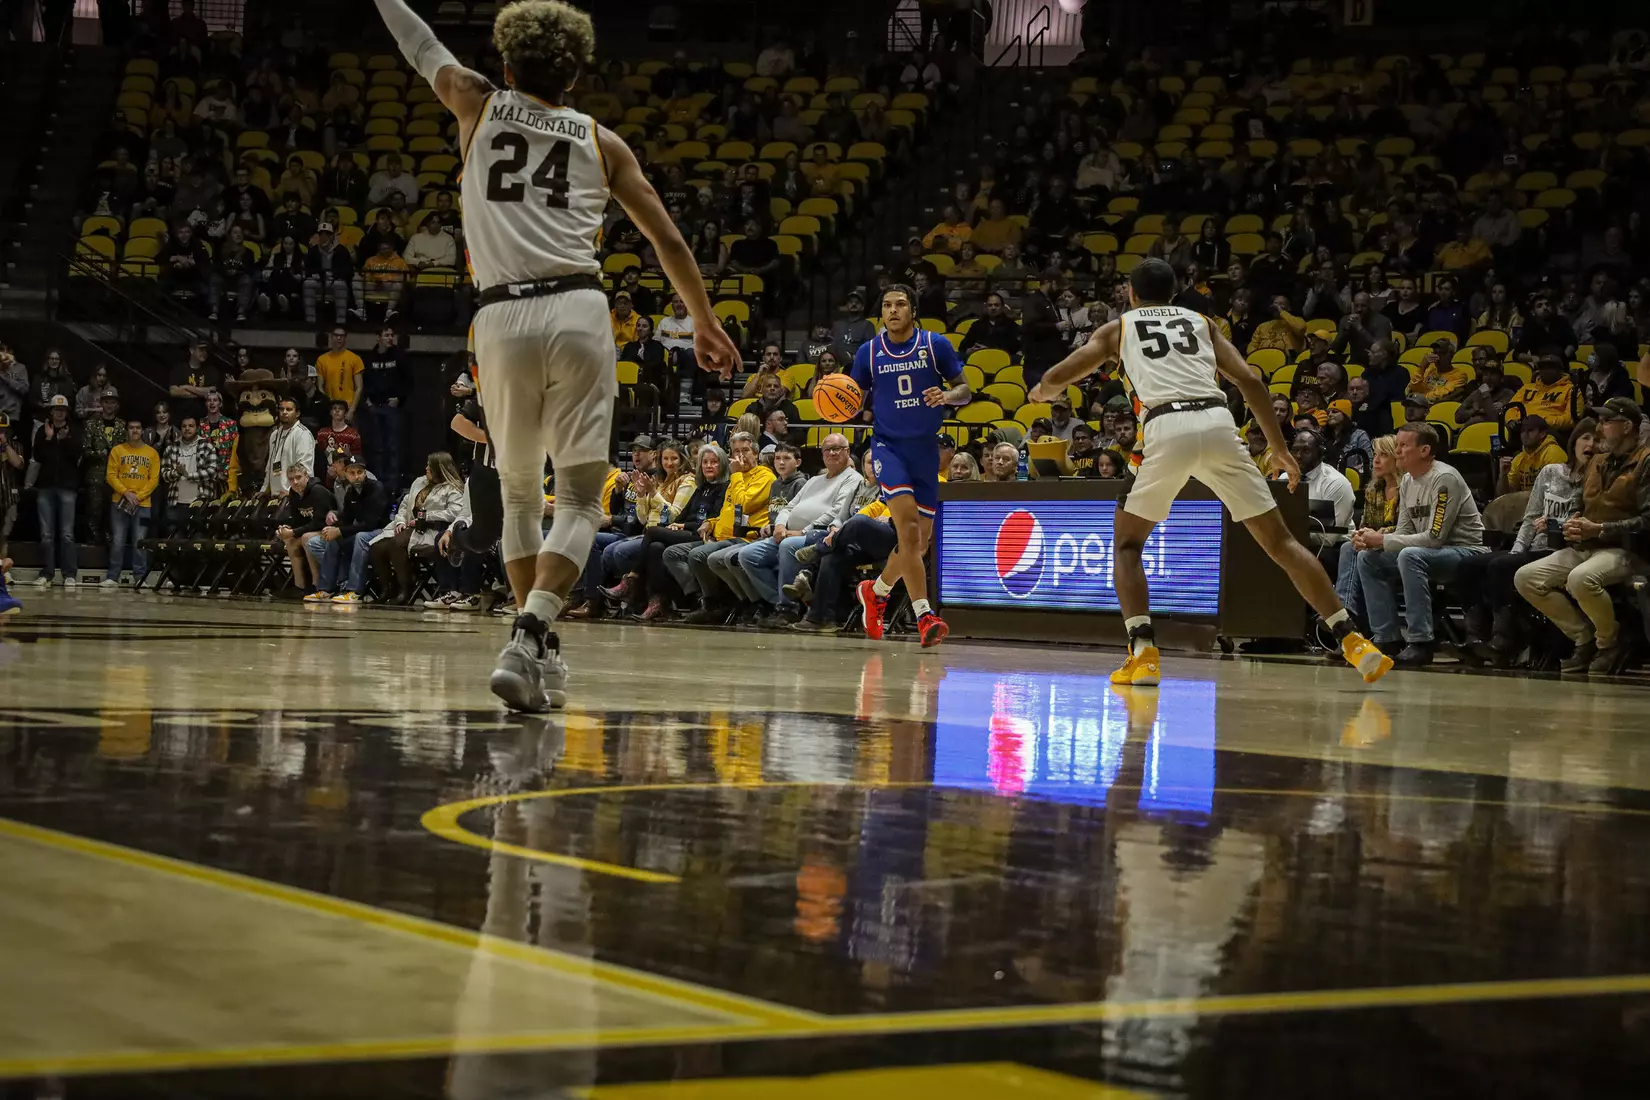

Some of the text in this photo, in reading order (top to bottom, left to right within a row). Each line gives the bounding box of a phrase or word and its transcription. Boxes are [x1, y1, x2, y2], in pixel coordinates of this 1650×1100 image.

[489, 104, 587, 140] MALDONADO
[487, 131, 571, 209] 24
[1138, 307, 1183, 317] DUSELL
[1134, 318, 1200, 360] 53
[878, 359, 928, 374] LOUISIANA
[897, 374, 913, 396] 0
[894, 398, 920, 409] TECH
